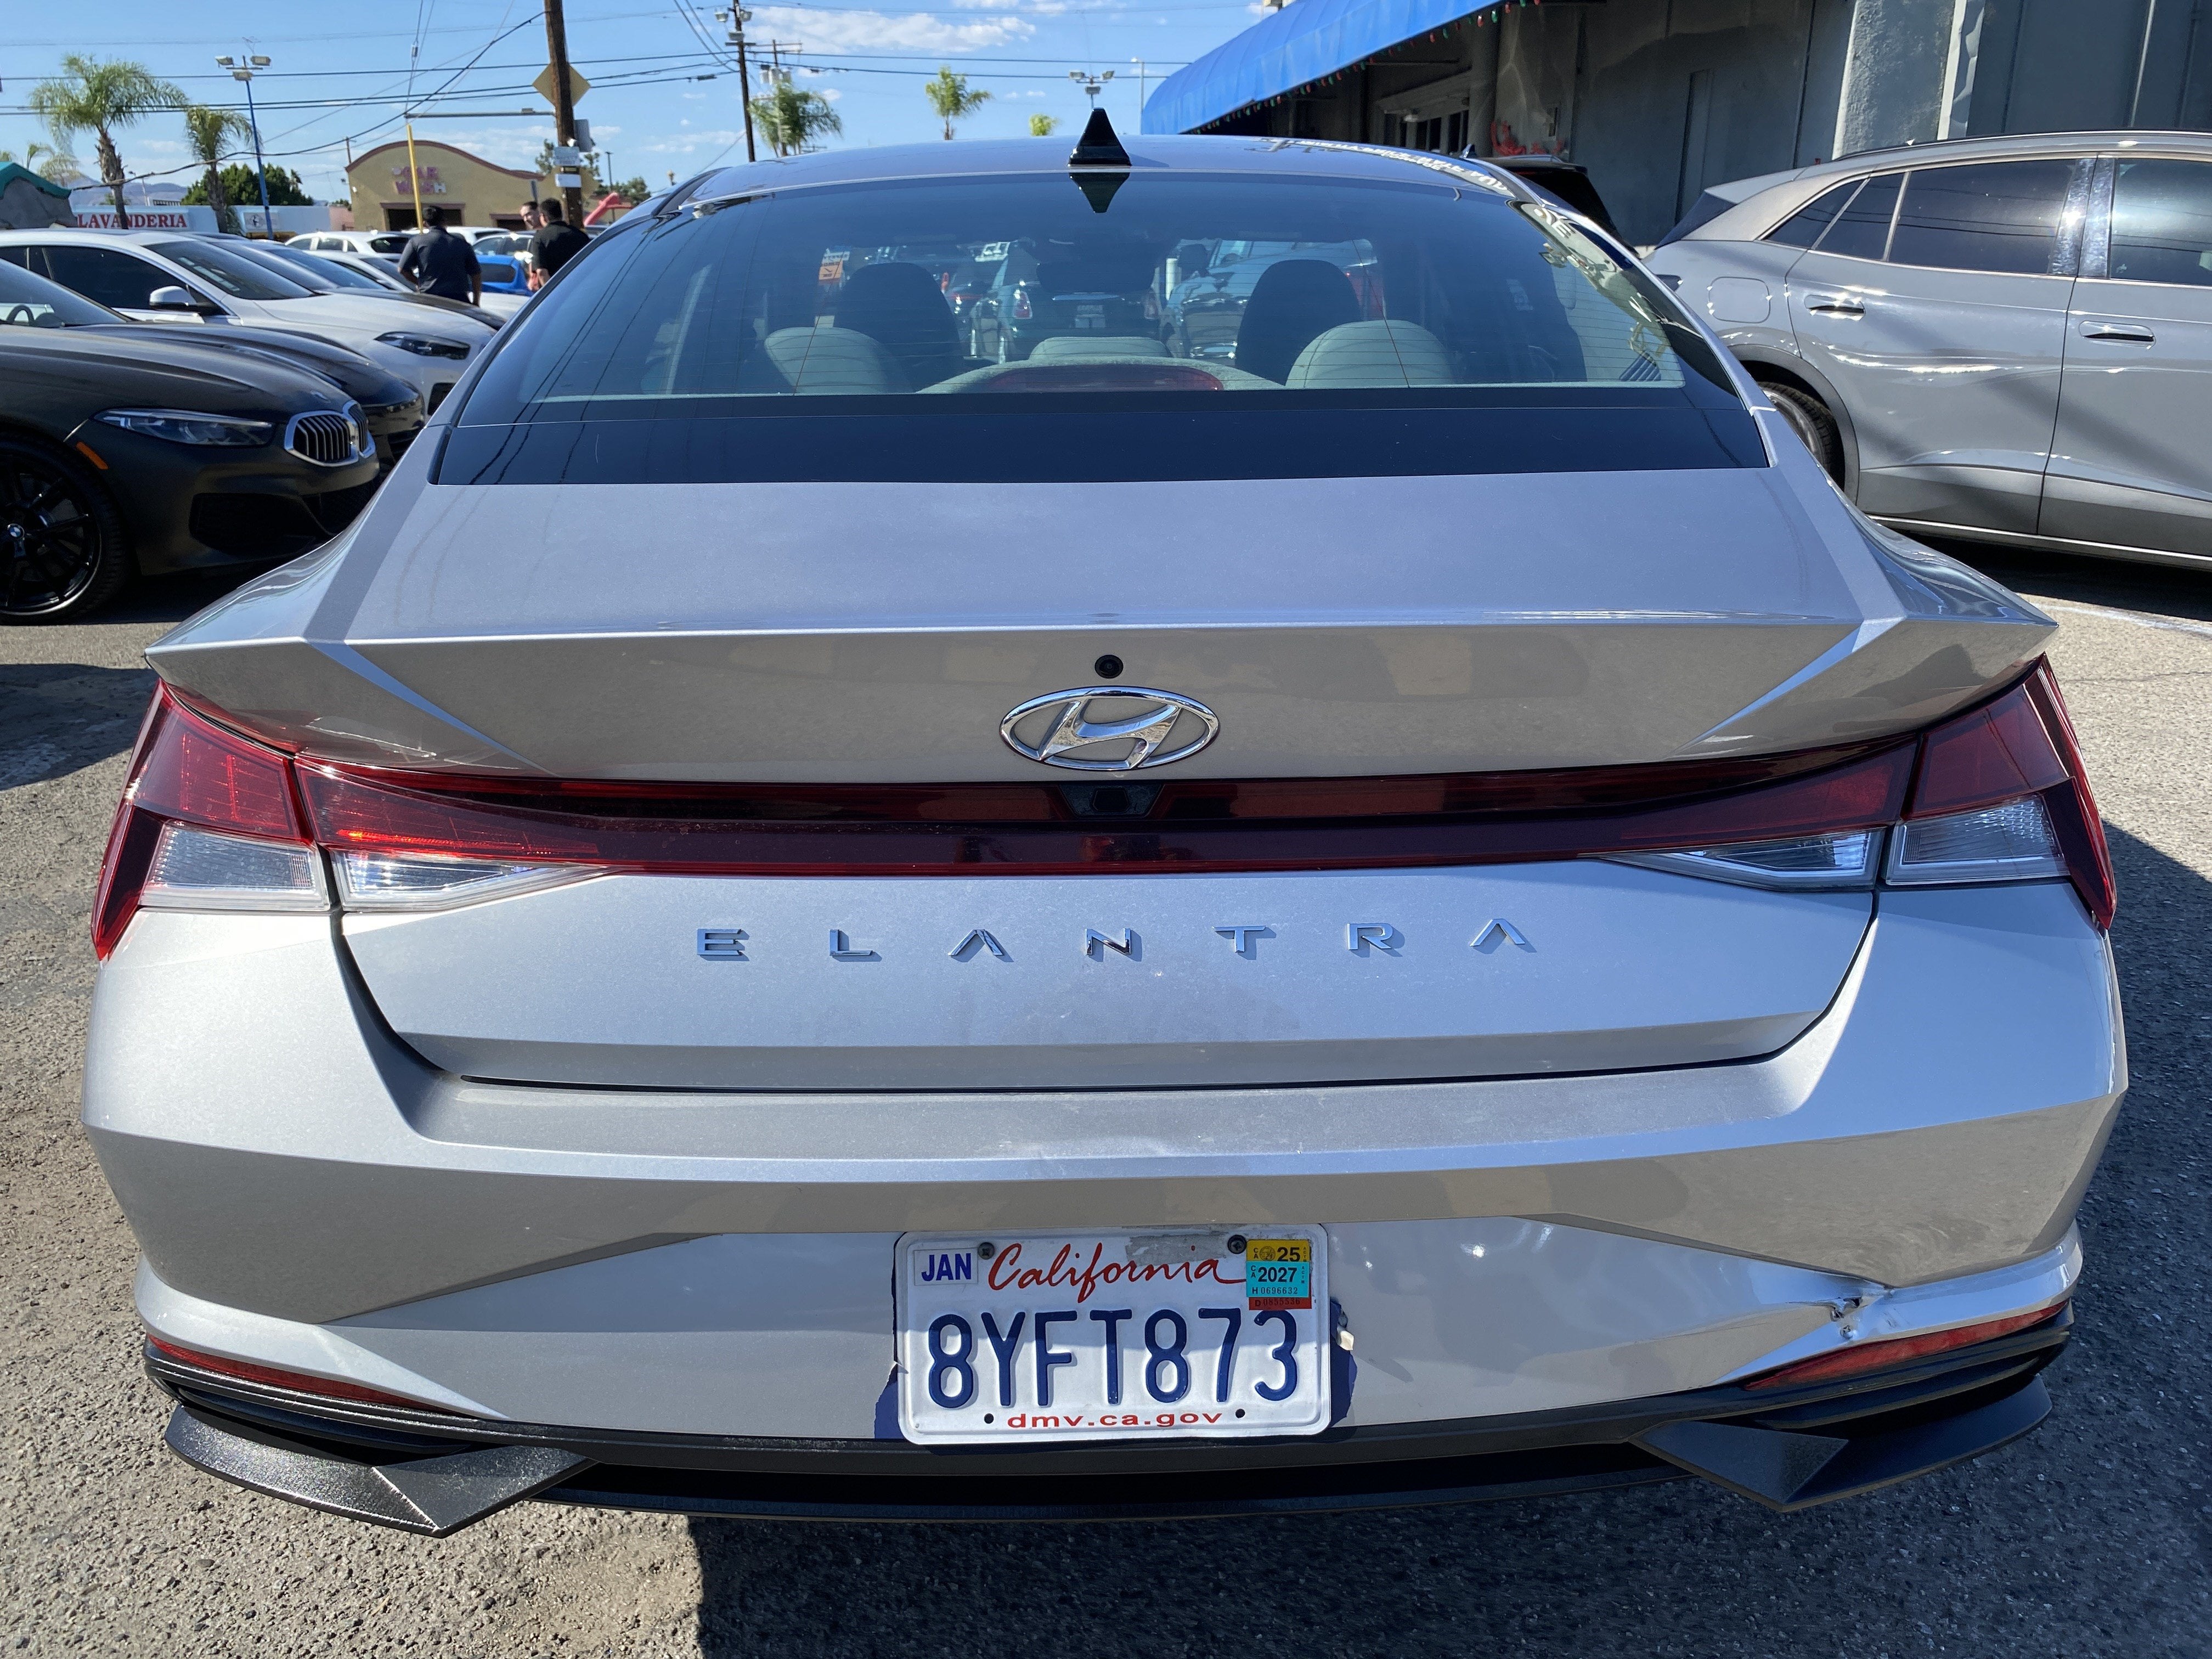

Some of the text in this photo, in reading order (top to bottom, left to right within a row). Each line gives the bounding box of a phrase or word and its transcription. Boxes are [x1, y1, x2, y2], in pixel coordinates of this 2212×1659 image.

[696, 918, 1526, 956] ELANTRA
[1277, 1246, 1300, 1262] 25
[921, 1252, 972, 1282] JAN
[988, 1242, 1247, 1304] California
[1257, 1266, 1297, 1283] 2027
[1260, 1286, 1298, 1295] 0696632
[928, 1308, 1298, 1408] 8YFT873
[1007, 1410, 1223, 1428] dmv.ca.gov
